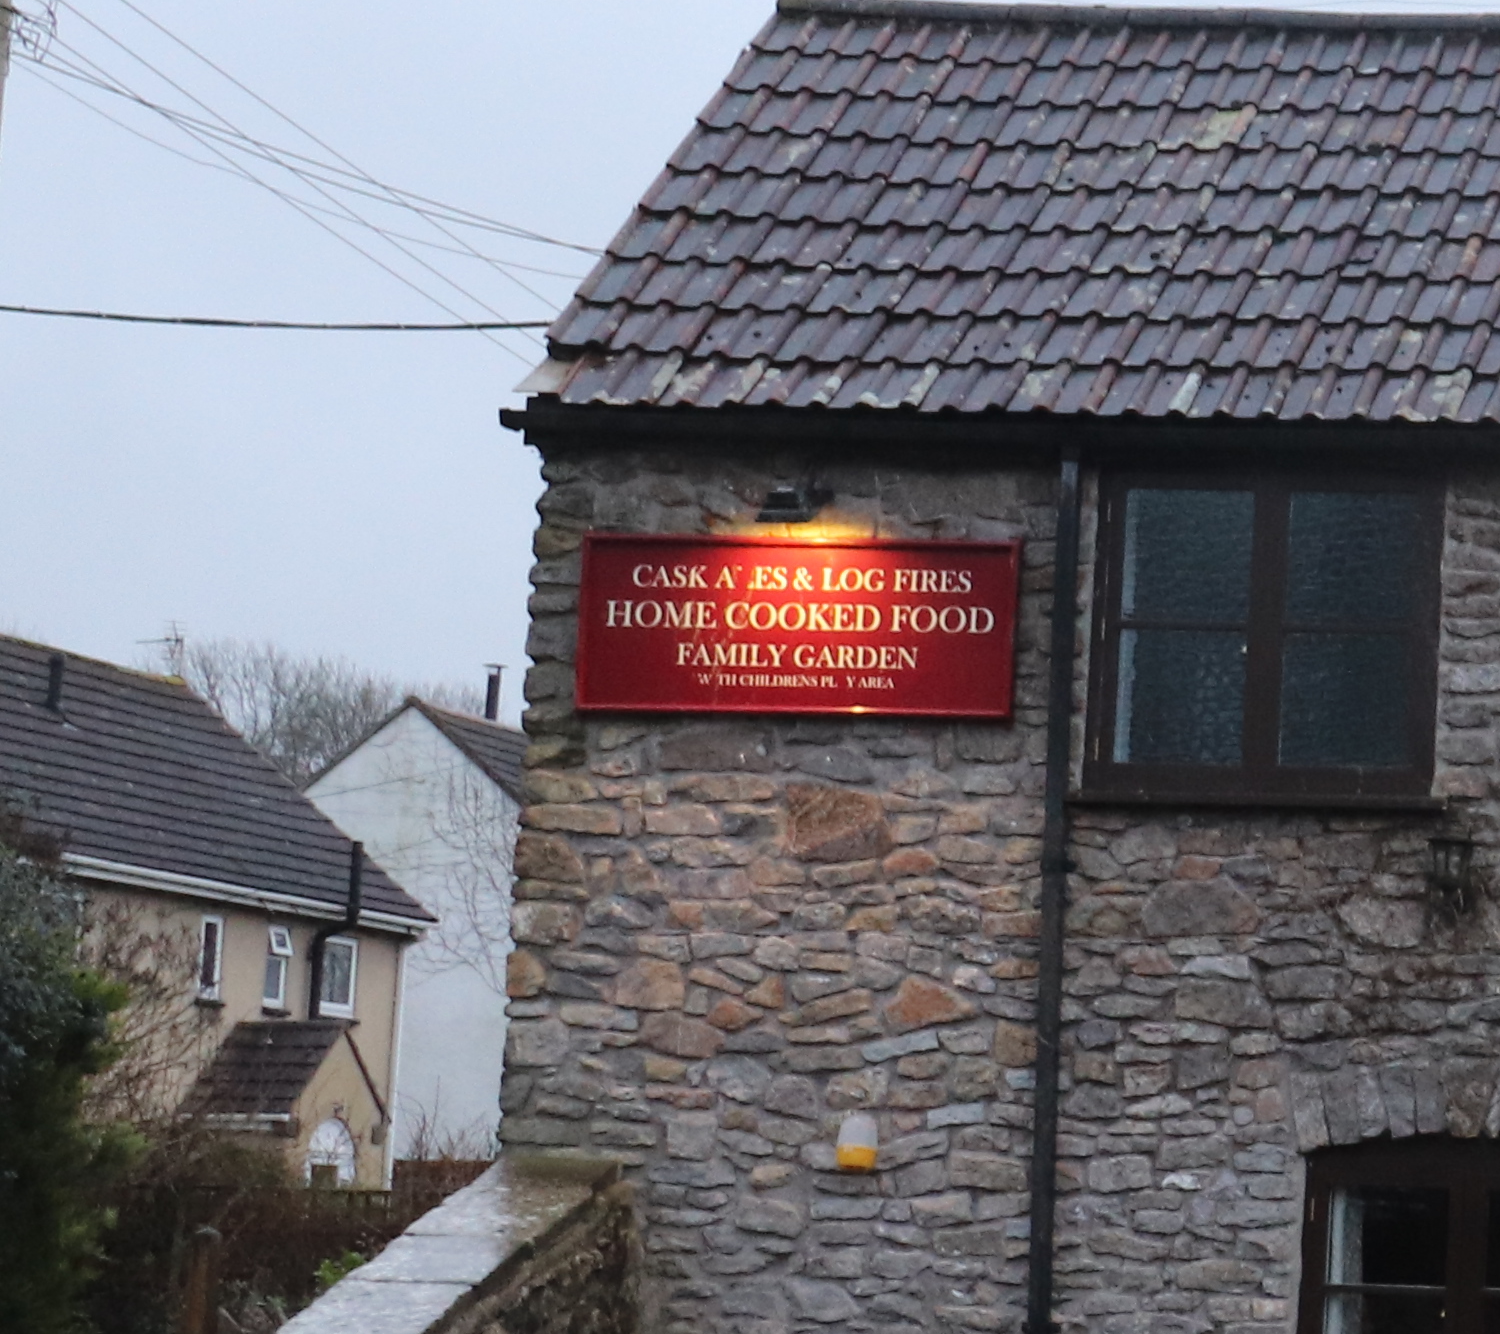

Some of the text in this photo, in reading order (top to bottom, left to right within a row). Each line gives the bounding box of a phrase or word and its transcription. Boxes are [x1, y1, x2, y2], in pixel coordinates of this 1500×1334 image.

[632, 564, 972, 594] CASK AES & LOG FIRES
[606, 599, 995, 634] HOME COOKED FOOD
[676, 642, 919, 670] FAMILY GARDEN
[696, 673, 895, 689] WTH CHILDRENS PLY AREA
